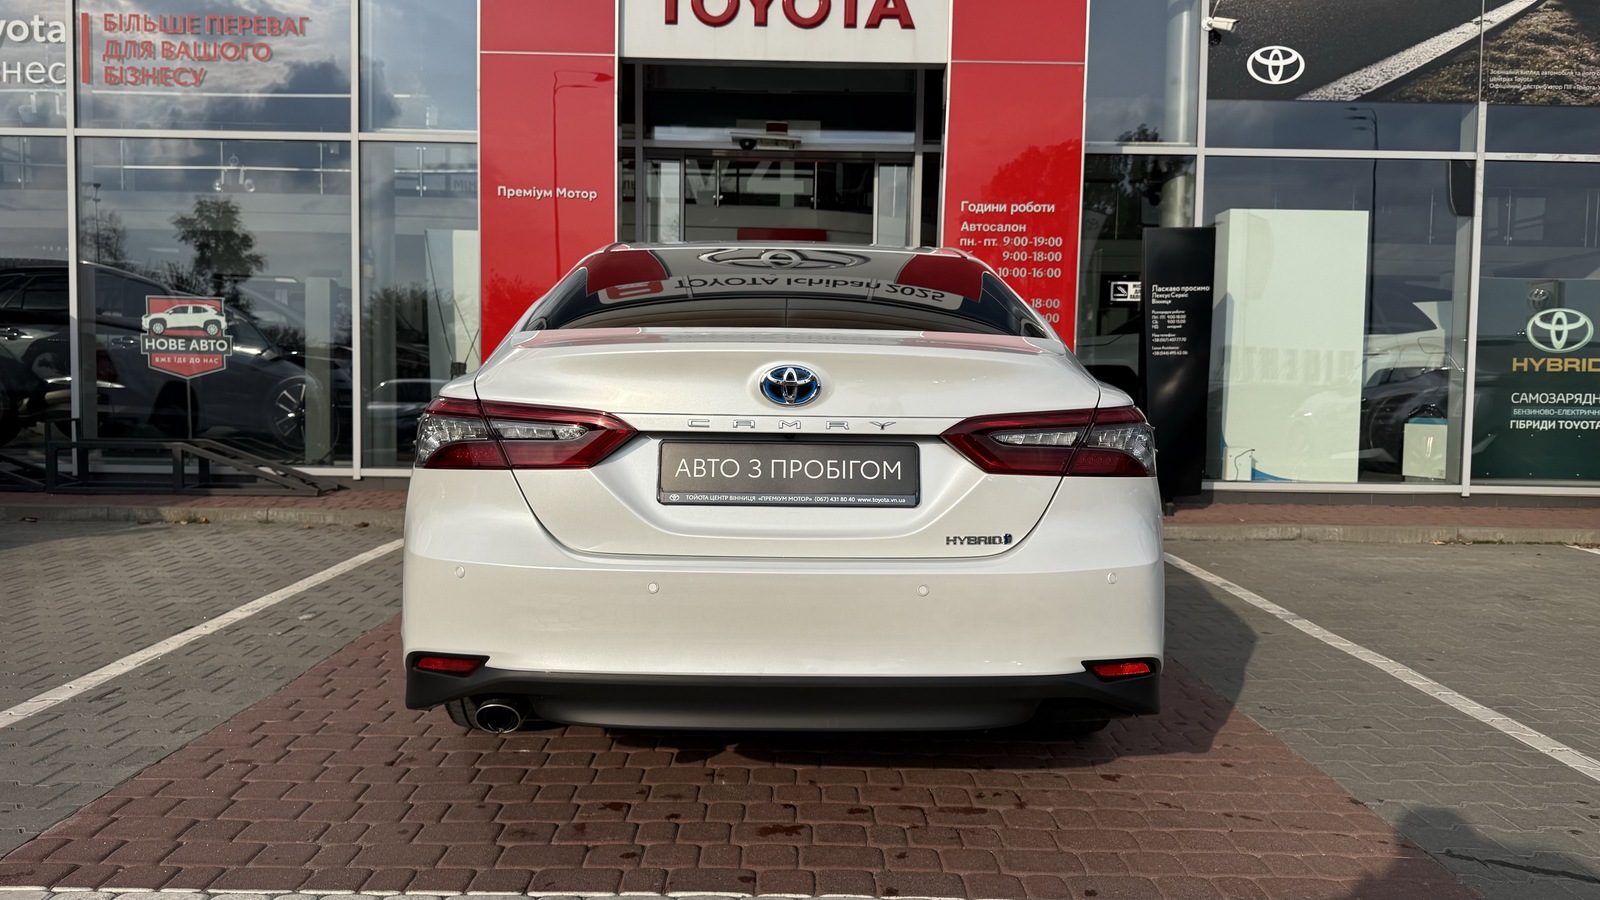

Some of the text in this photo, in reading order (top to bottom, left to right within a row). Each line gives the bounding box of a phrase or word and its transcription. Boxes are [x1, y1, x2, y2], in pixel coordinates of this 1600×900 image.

[664, 0, 915, 29] TOYOTA
[103, 13, 312, 36] БІЛЬШЕ ПЕРЕВАГ
[102, 40, 272, 62] ДЛЯ ВАШОГО
[103, 66, 206, 87] БІЗНЕСУ
[497, 185, 598, 202] Преміум Мотор
[960, 200, 1056, 215] Години роботи
[960, 221, 1027, 233] Автосалон
[1002, 236, 1063, 248] 9:00-19:00
[1002, 251, 1063, 262] 9:00-18:00
[998, 267, 1062, 278] 10:00-16:00
[1151, 284, 1180, 293] Ласкаво
[145, 338, 228, 352] НОВЕ АВТО
[155, 356, 171, 364] ВЖЕ
[173, 356, 187, 364] ЇДЕ
[189, 357, 201, 365] ДО
[687, 418, 897, 430] CAMRY
[1510, 420, 1556, 431] ГІБРИДИ
[674, 458, 741, 479] АВТО
[770, 459, 902, 481] ПРОБІГОМ
[686, 493, 709, 501] ТОЙОТА
[709, 494, 729, 503] ЦЕНТР
[729, 494, 756, 503] ВІННИЦЯ
[814, 495, 829, 503] (067)
[857, 496, 906, 504] www.toyota.vn.ua
